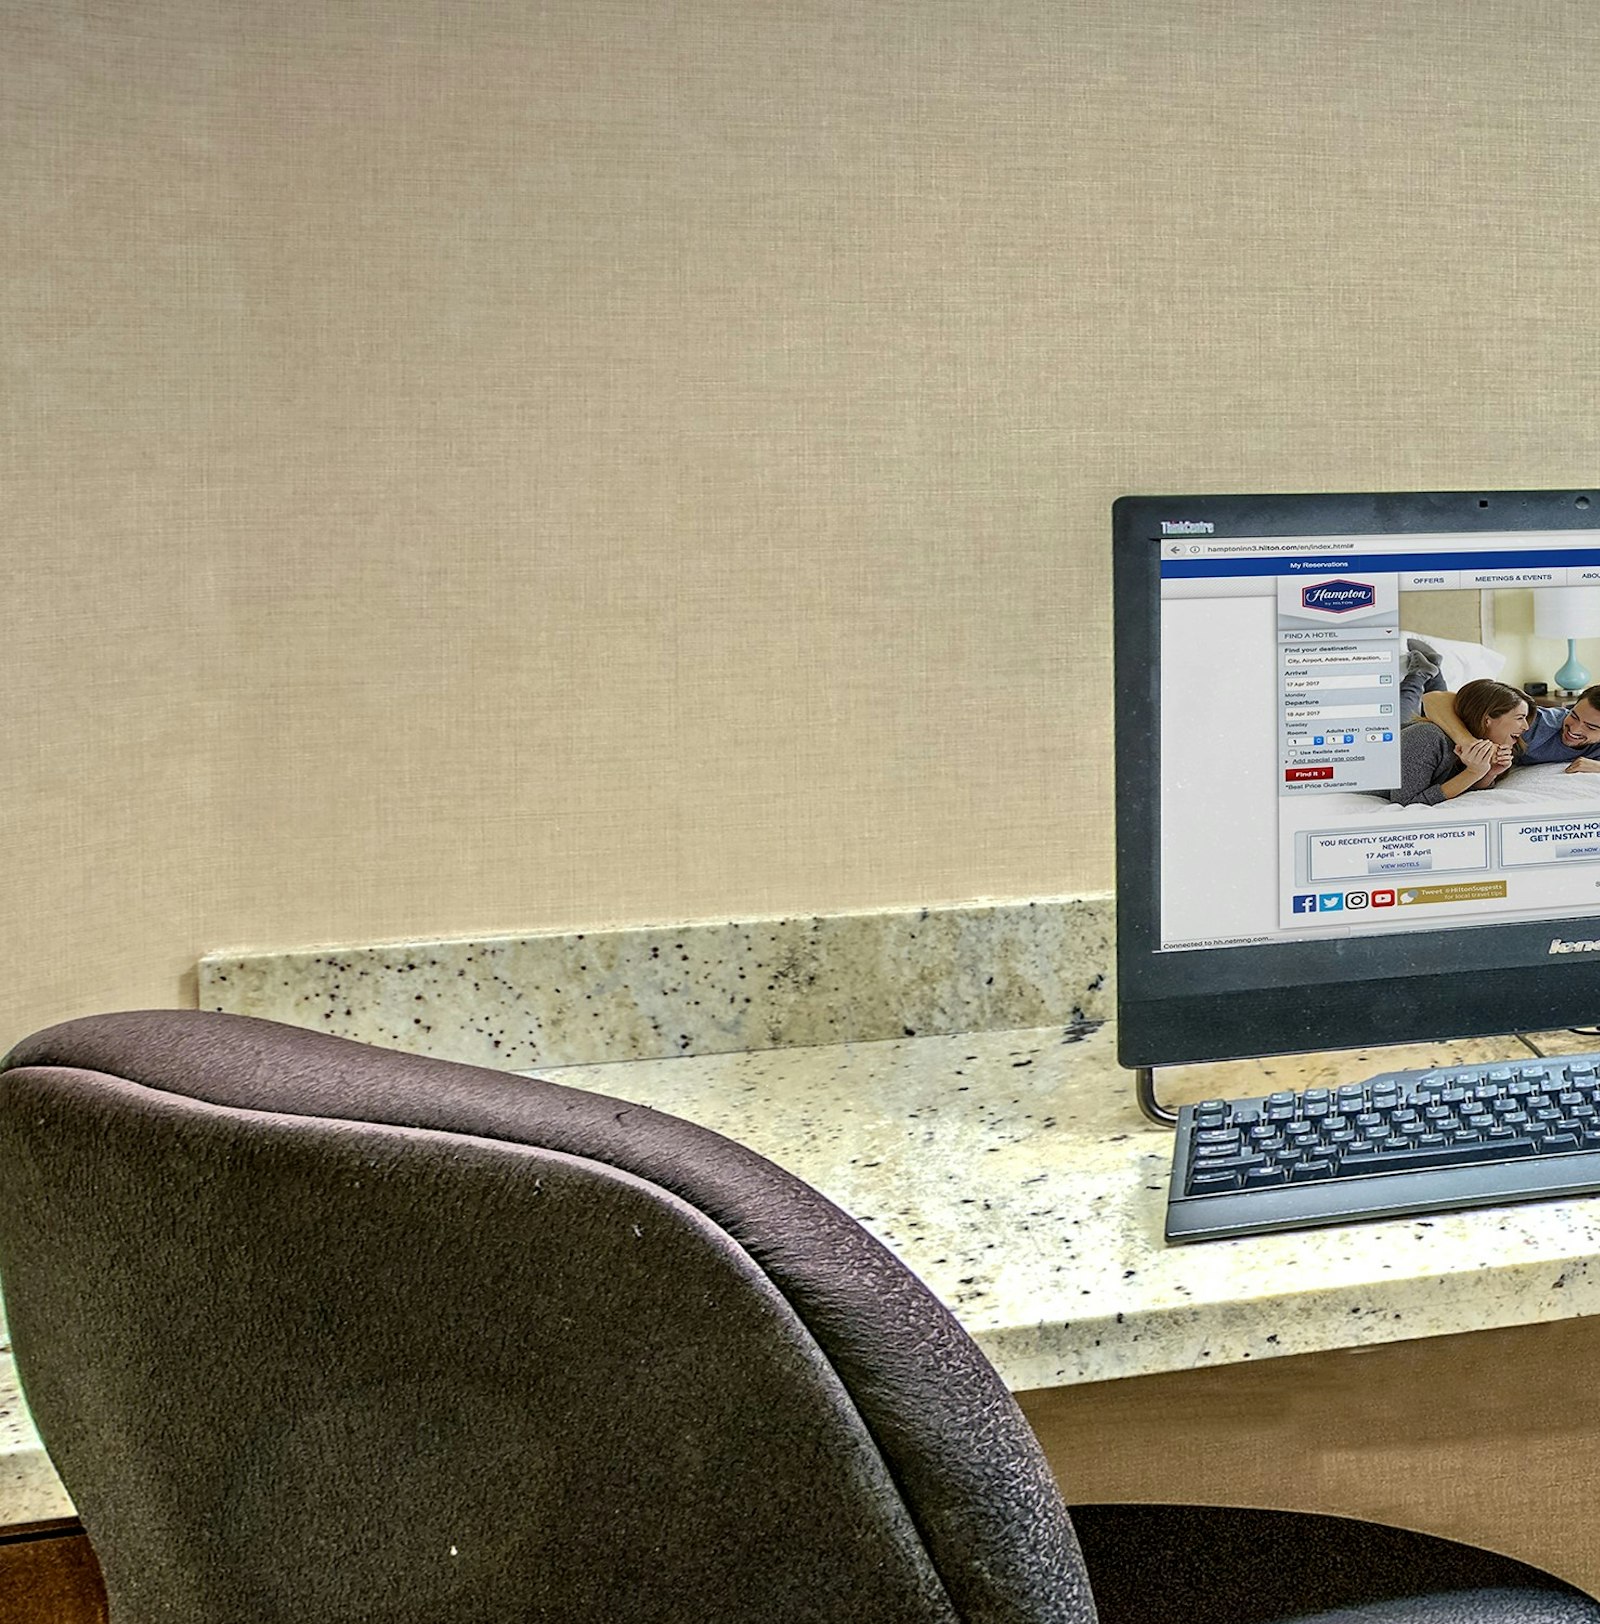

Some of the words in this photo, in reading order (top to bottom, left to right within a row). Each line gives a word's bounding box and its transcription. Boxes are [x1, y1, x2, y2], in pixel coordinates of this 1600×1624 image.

[1306, 588, 1371, 602] Hampton
[1519, 826, 1542, 835] JOIN
[1545, 823, 1580, 833] HILTON
[1338, 837, 1377, 845] RECENTLY
[1379, 834, 1418, 843] SEARCHED
[1437, 831, 1466, 839] HOTELS
[1552, 832, 1594, 840] INSTANT
[1376, 851, 1395, 859] April
